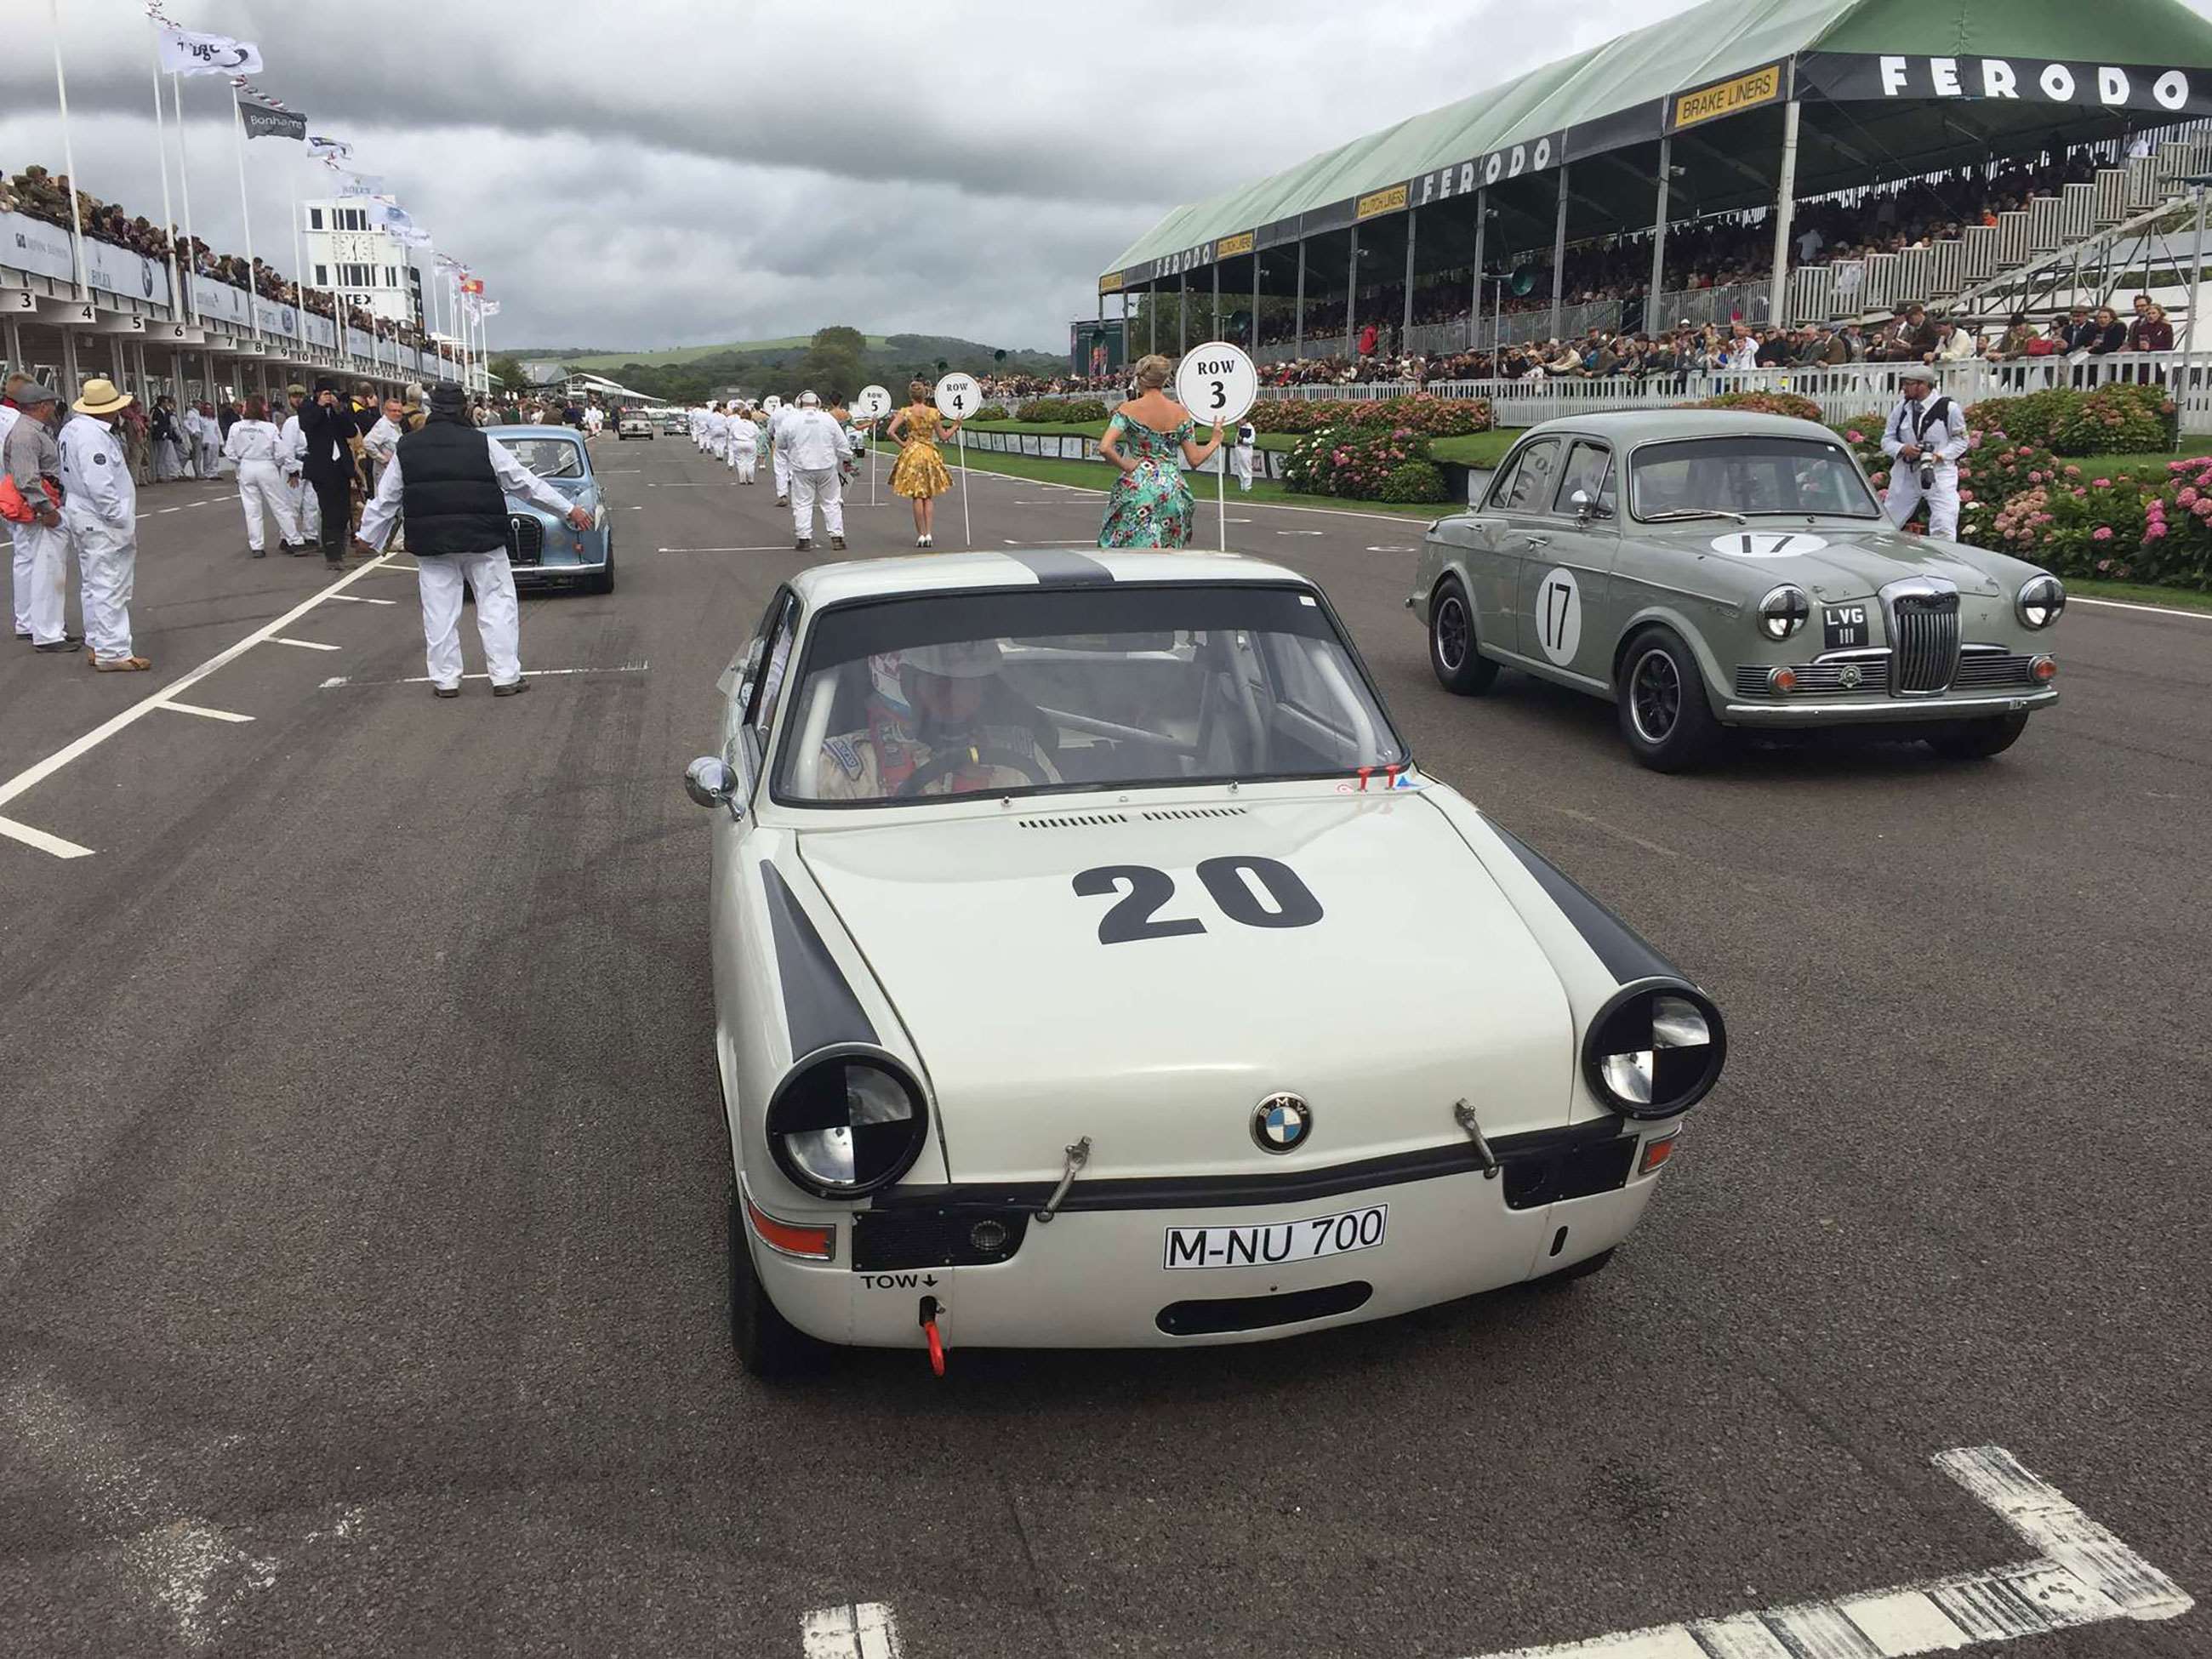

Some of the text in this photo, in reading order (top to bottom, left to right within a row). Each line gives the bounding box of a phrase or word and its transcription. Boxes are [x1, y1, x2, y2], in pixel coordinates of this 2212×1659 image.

[1879, 55, 2190, 111] FERODO
[1682, 74, 1772, 120] BRAKE LINERS
[1421, 137, 1551, 206] FERODO
[1154, 243, 1211, 279] FERODO
[20, 293, 31, 308] 3
[82, 305, 93, 319] 4
[133, 316, 141, 329] 5
[174, 325, 184, 337] 6
[226, 337, 233, 347] 7
[254, 342, 262, 352] 8
[281, 347, 288, 357] 9
[298, 353, 309, 362] 10
[319, 356, 328, 365] 11
[334, 360, 345, 369] 12
[1197, 360, 1234, 375] ROW
[946, 383, 968, 392] ROW
[1210, 381, 1227, 409] 3
[871, 400, 879, 412] 5
[952, 394, 964, 410] 4
[1742, 534, 1795, 554] 17
[1547, 582, 1571, 650] 17
[1826, 607, 1864, 626] LVG
[1070, 854, 1325, 945] 20
[1259, 1097, 1308, 1117] BMW
[1169, 1209, 1382, 1266] M-NU 700
[859, 1274, 918, 1290] TOW
